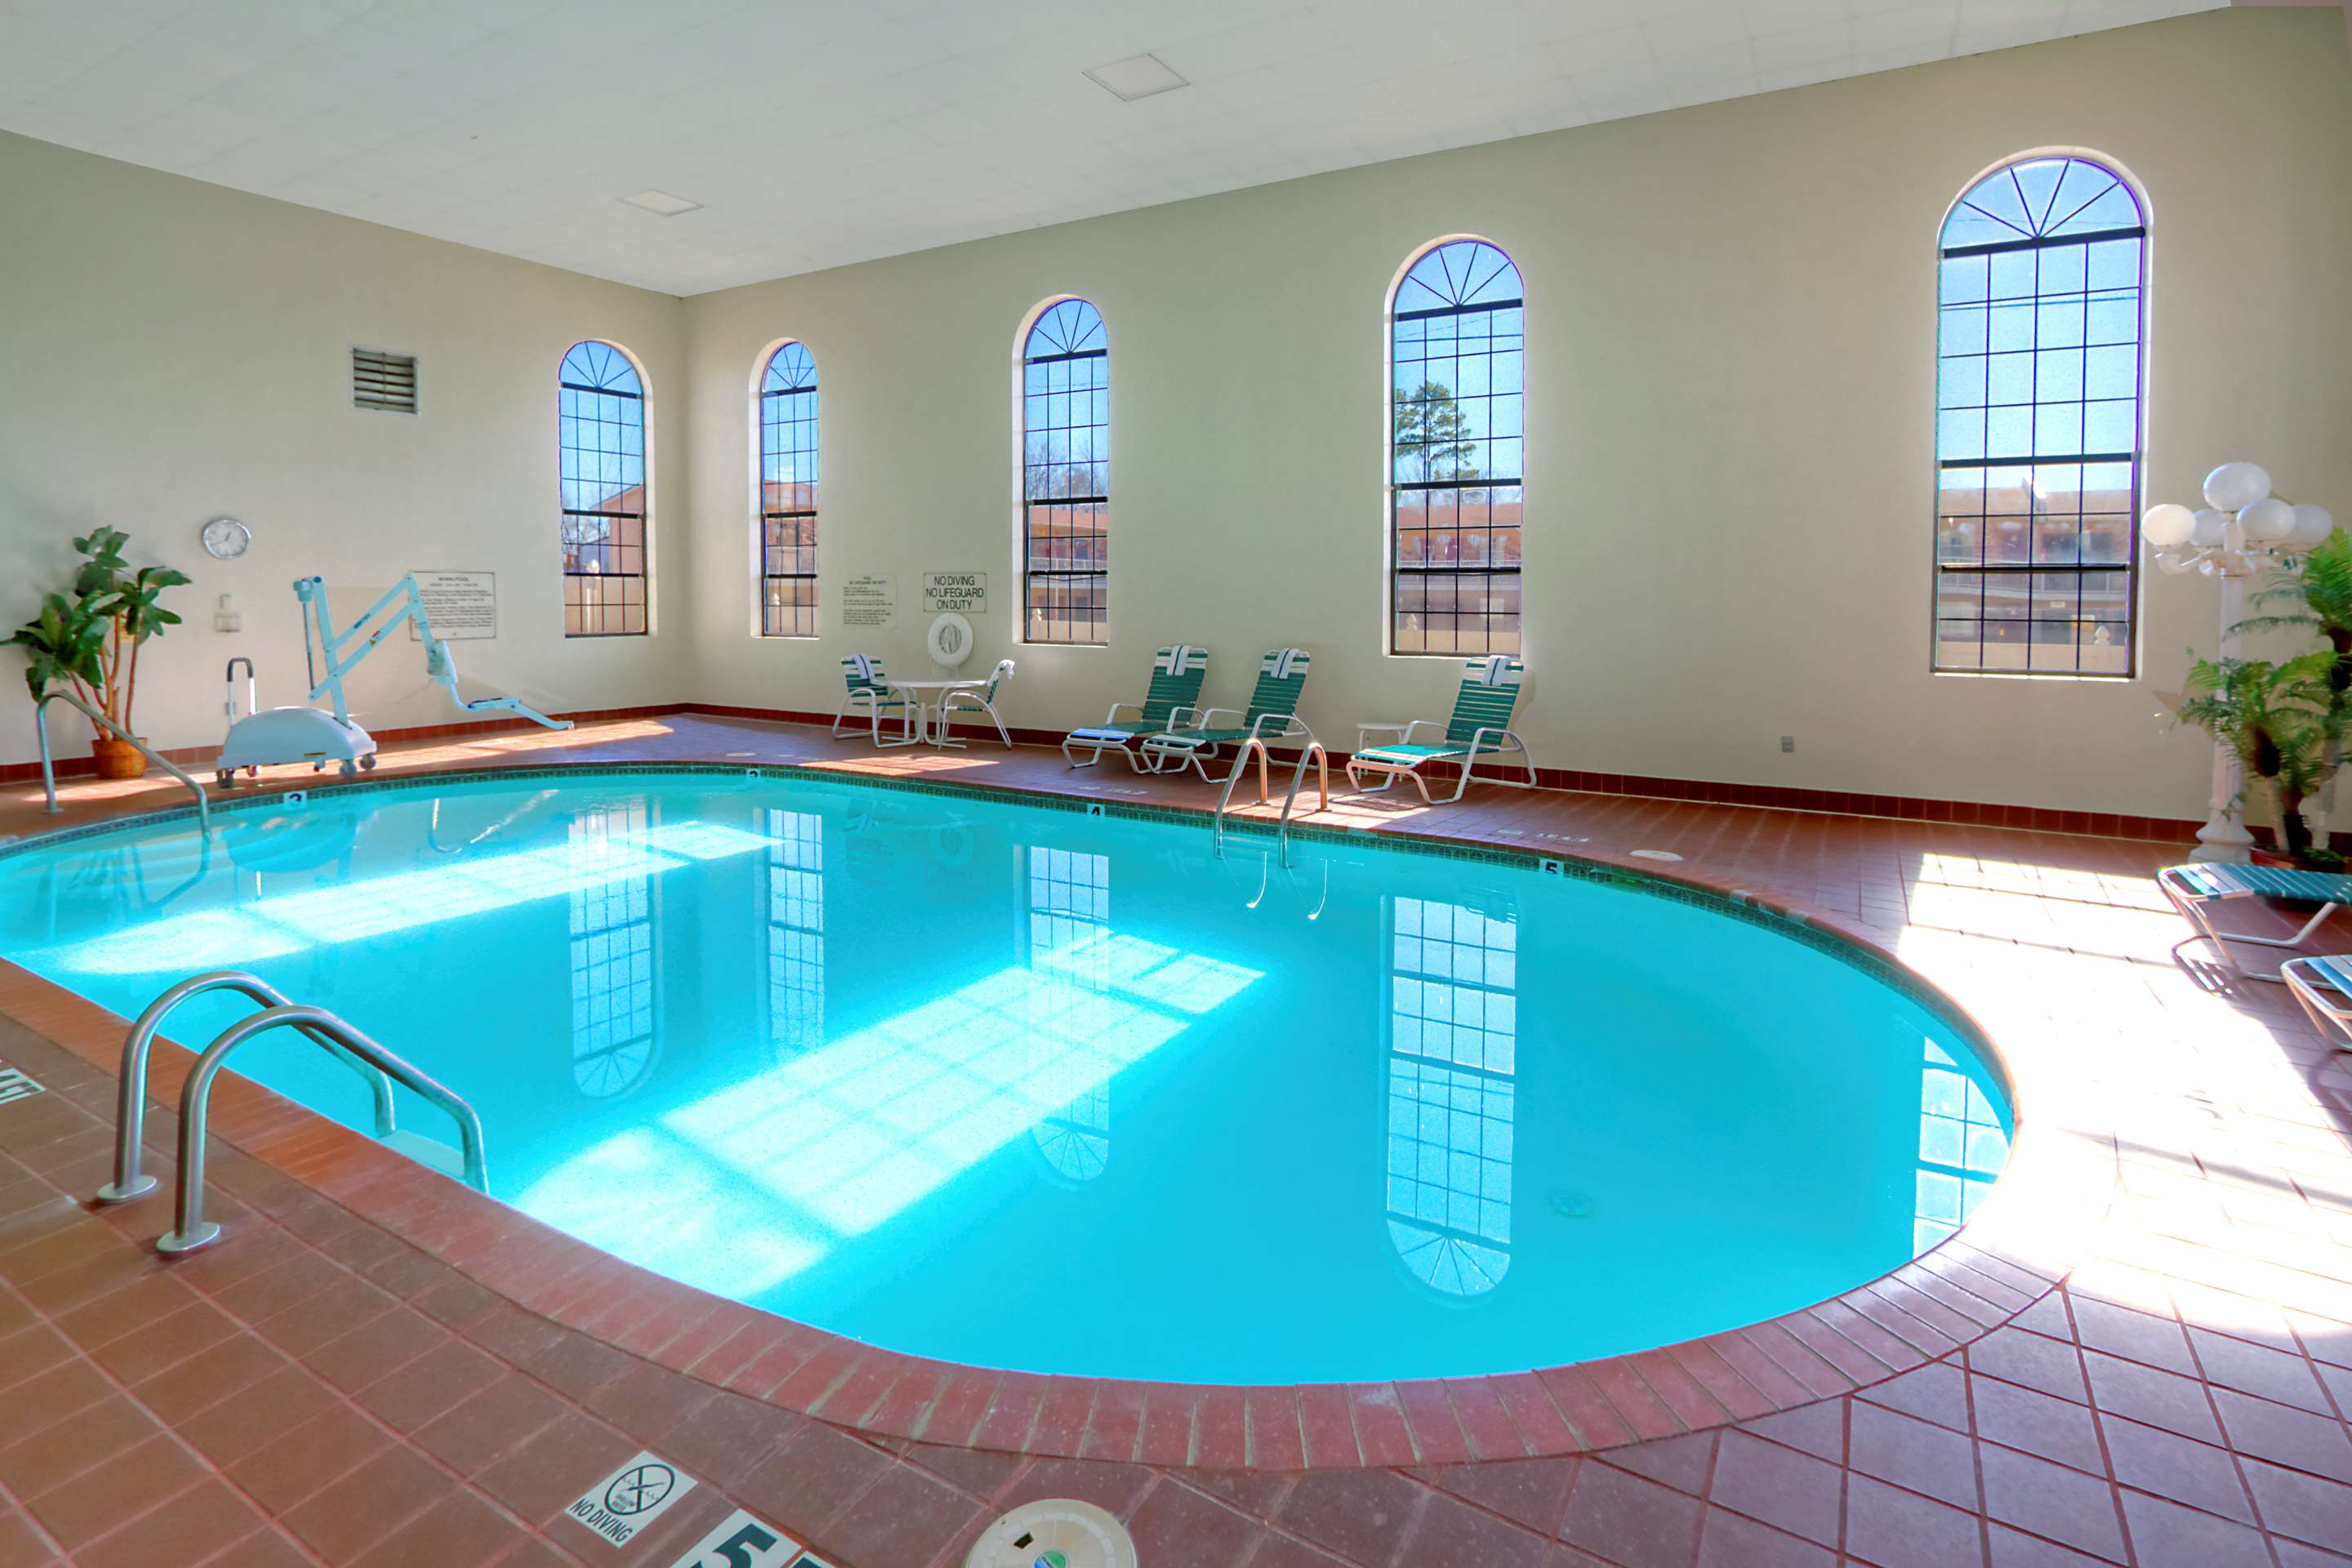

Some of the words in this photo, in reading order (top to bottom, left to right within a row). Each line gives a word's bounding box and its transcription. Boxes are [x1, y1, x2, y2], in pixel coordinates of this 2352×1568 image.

[934, 576, 947, 586] NO
[947, 576, 975, 586] DIVING
[926, 588, 938, 598] NO
[939, 588, 984, 598] LIFEGUARD
[936, 599, 948, 609] ON
[949, 599, 973, 609] DUTY
[1545, 862, 1558, 875] 5
[569, 1499, 595, 1517] NO
[586, 1508, 633, 1542] DIVING
[689, 1523, 777, 1568] 5
